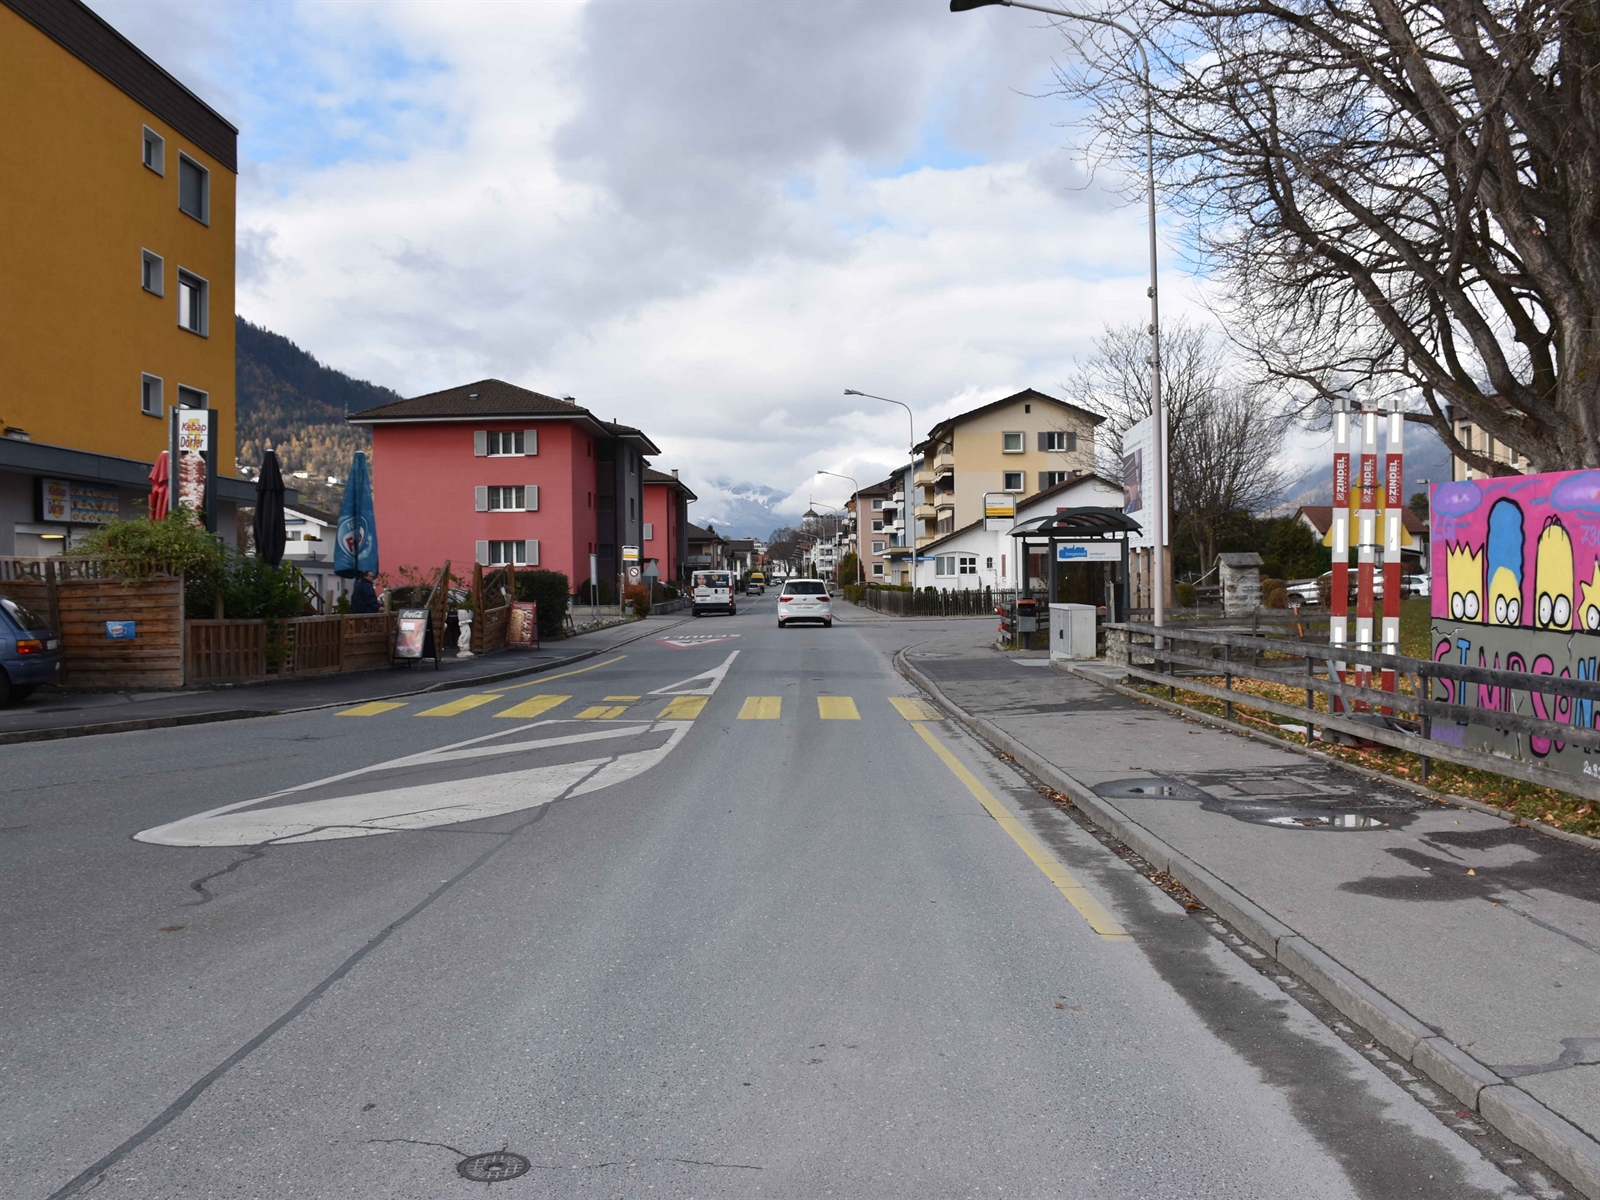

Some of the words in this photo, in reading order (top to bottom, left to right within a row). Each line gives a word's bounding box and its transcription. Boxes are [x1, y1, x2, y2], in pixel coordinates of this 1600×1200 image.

[181, 422, 207, 433] Kebap
[1336, 456, 1345, 493] ZINDEL
[1389, 460, 1398, 496] ZINDEL
[1434, 637, 1600, 758] SIMPSON
